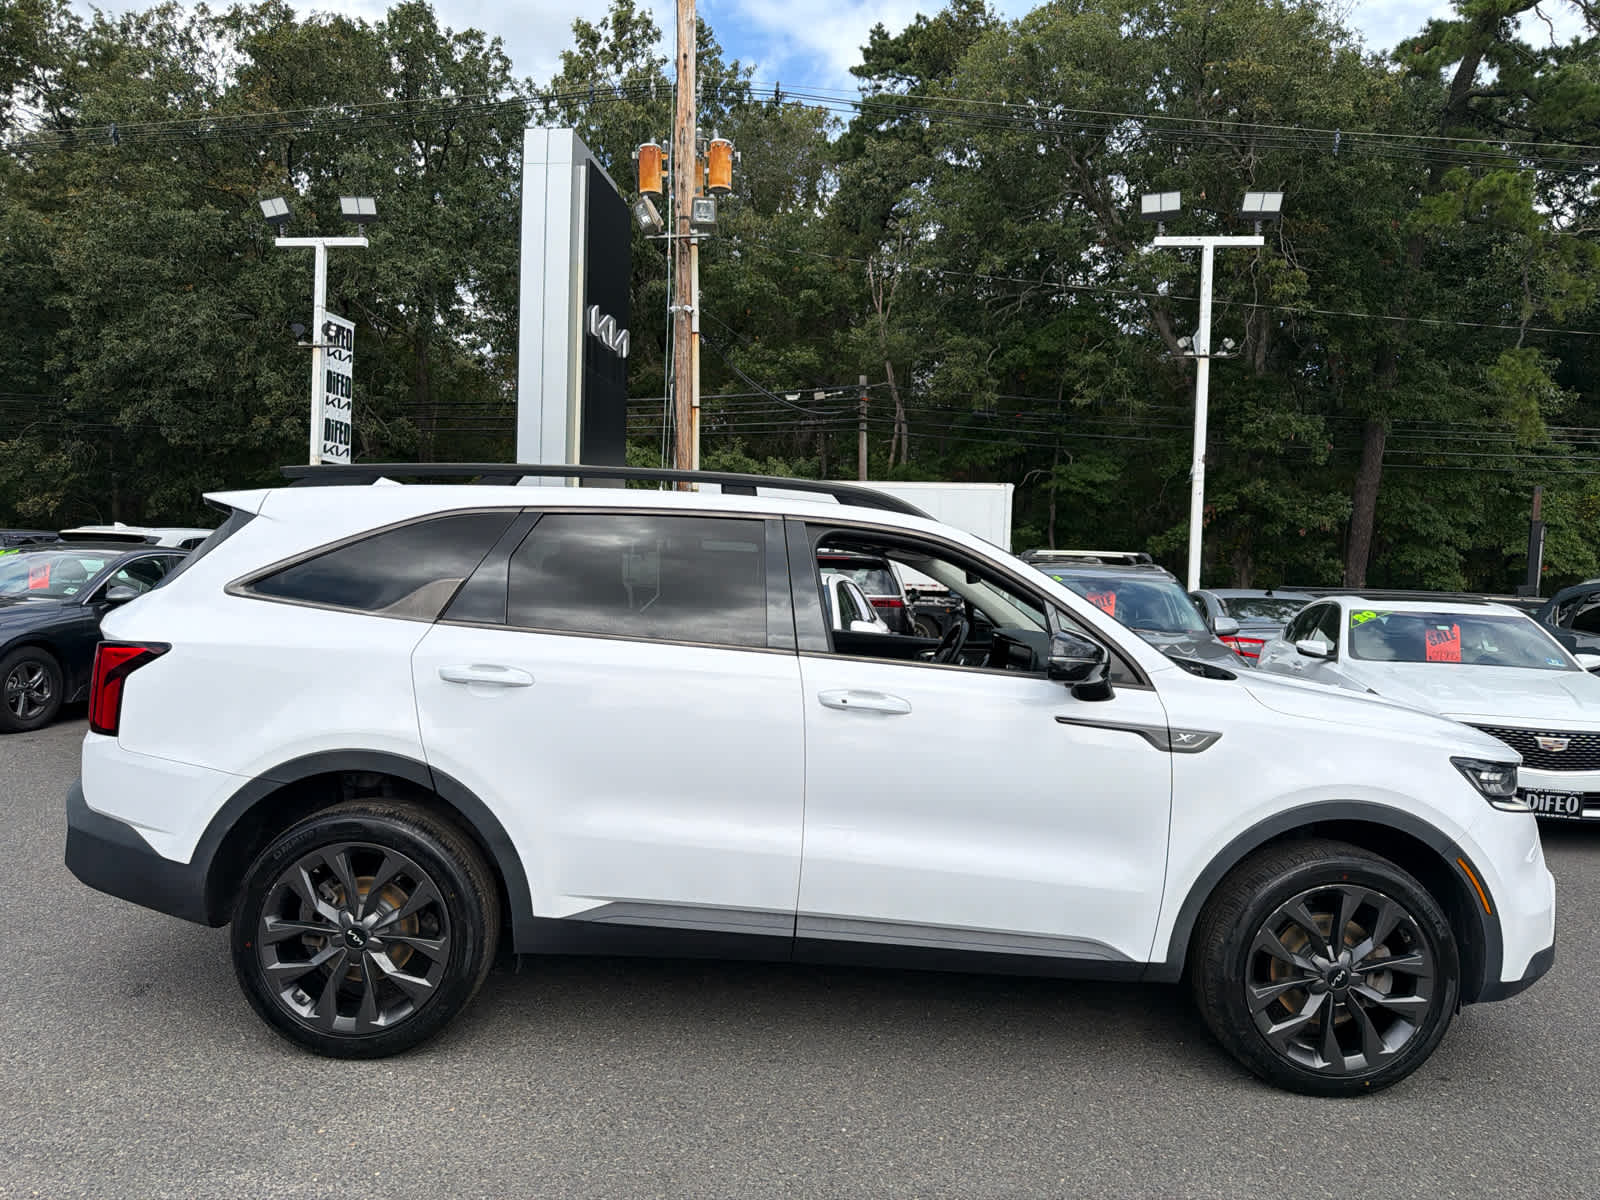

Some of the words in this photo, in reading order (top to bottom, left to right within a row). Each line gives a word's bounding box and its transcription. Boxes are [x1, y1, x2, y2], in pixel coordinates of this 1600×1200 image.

[588, 305, 630, 358] KIA
[327, 348, 352, 363] KIA
[325, 394, 351, 411] KIA
[323, 443, 349, 458] KIA
[1427, 630, 1457, 646] SALE
[1526, 793, 1579, 814] DiFEO
